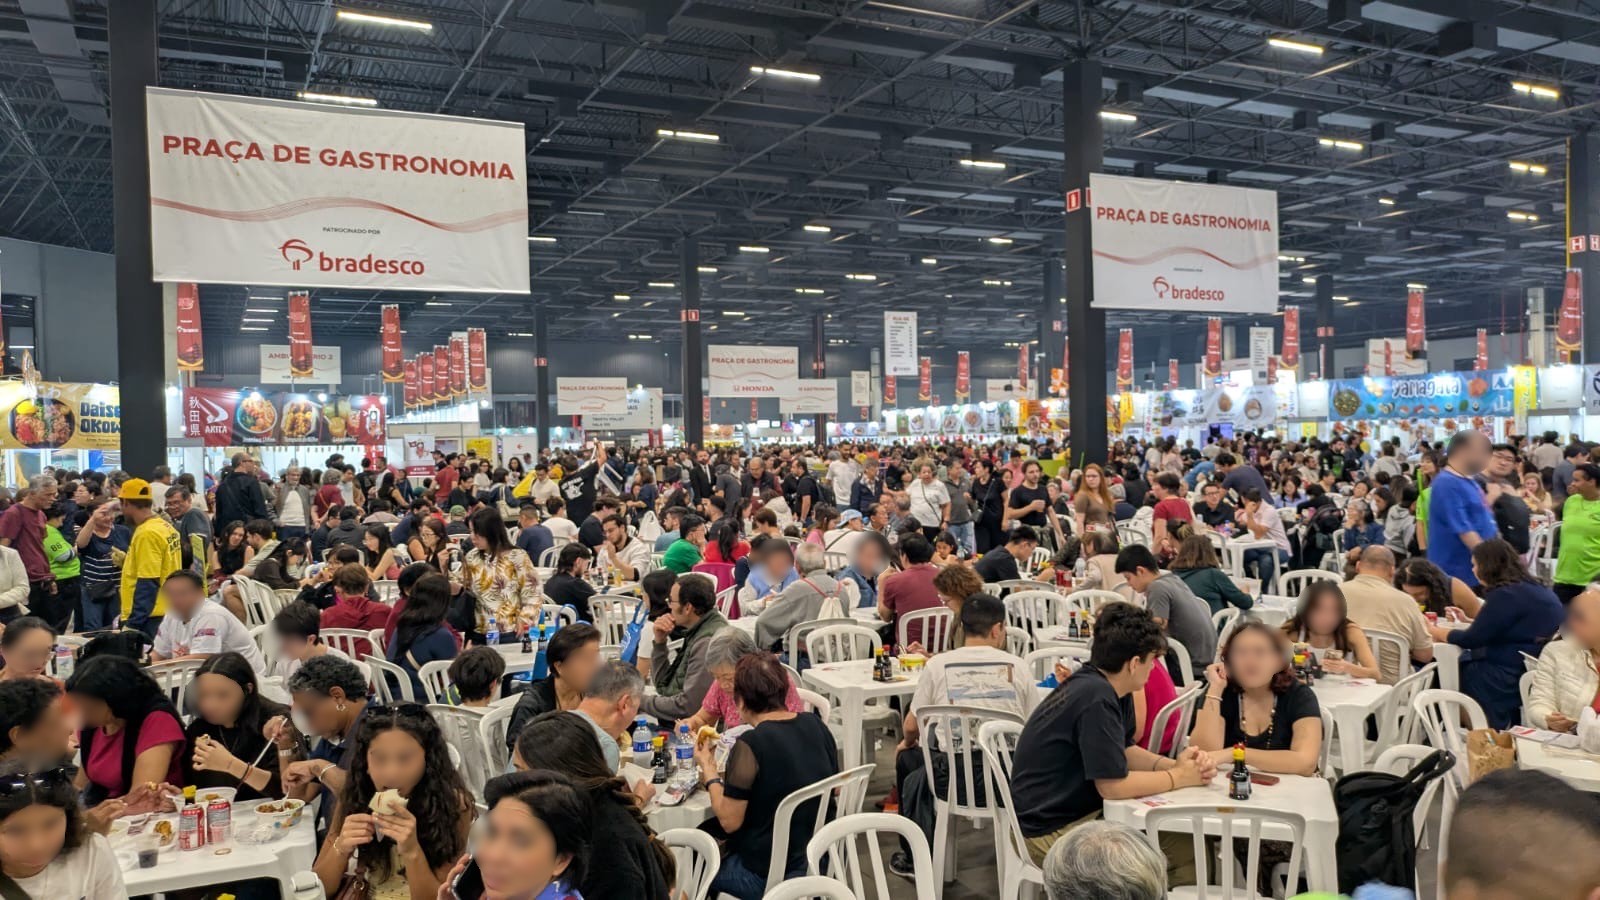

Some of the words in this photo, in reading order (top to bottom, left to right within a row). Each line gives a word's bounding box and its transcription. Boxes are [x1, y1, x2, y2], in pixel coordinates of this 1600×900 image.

[162, 135, 265, 164] PRAÇA
[273, 144, 311, 165] DE
[319, 148, 515, 180] GASTRONOMIA
[1096, 206, 1147, 225] PRAÇA
[1150, 211, 1169, 225] DE
[1172, 213, 1272, 232] GASTRONOMIA
[322, 226, 367, 234] PATROCINADO
[319, 251, 425, 276] bradesco
[1172, 285, 1225, 301] bradesco
[711, 357, 735, 365] PRAÇA
[204, 424, 228, 434] AKITA
